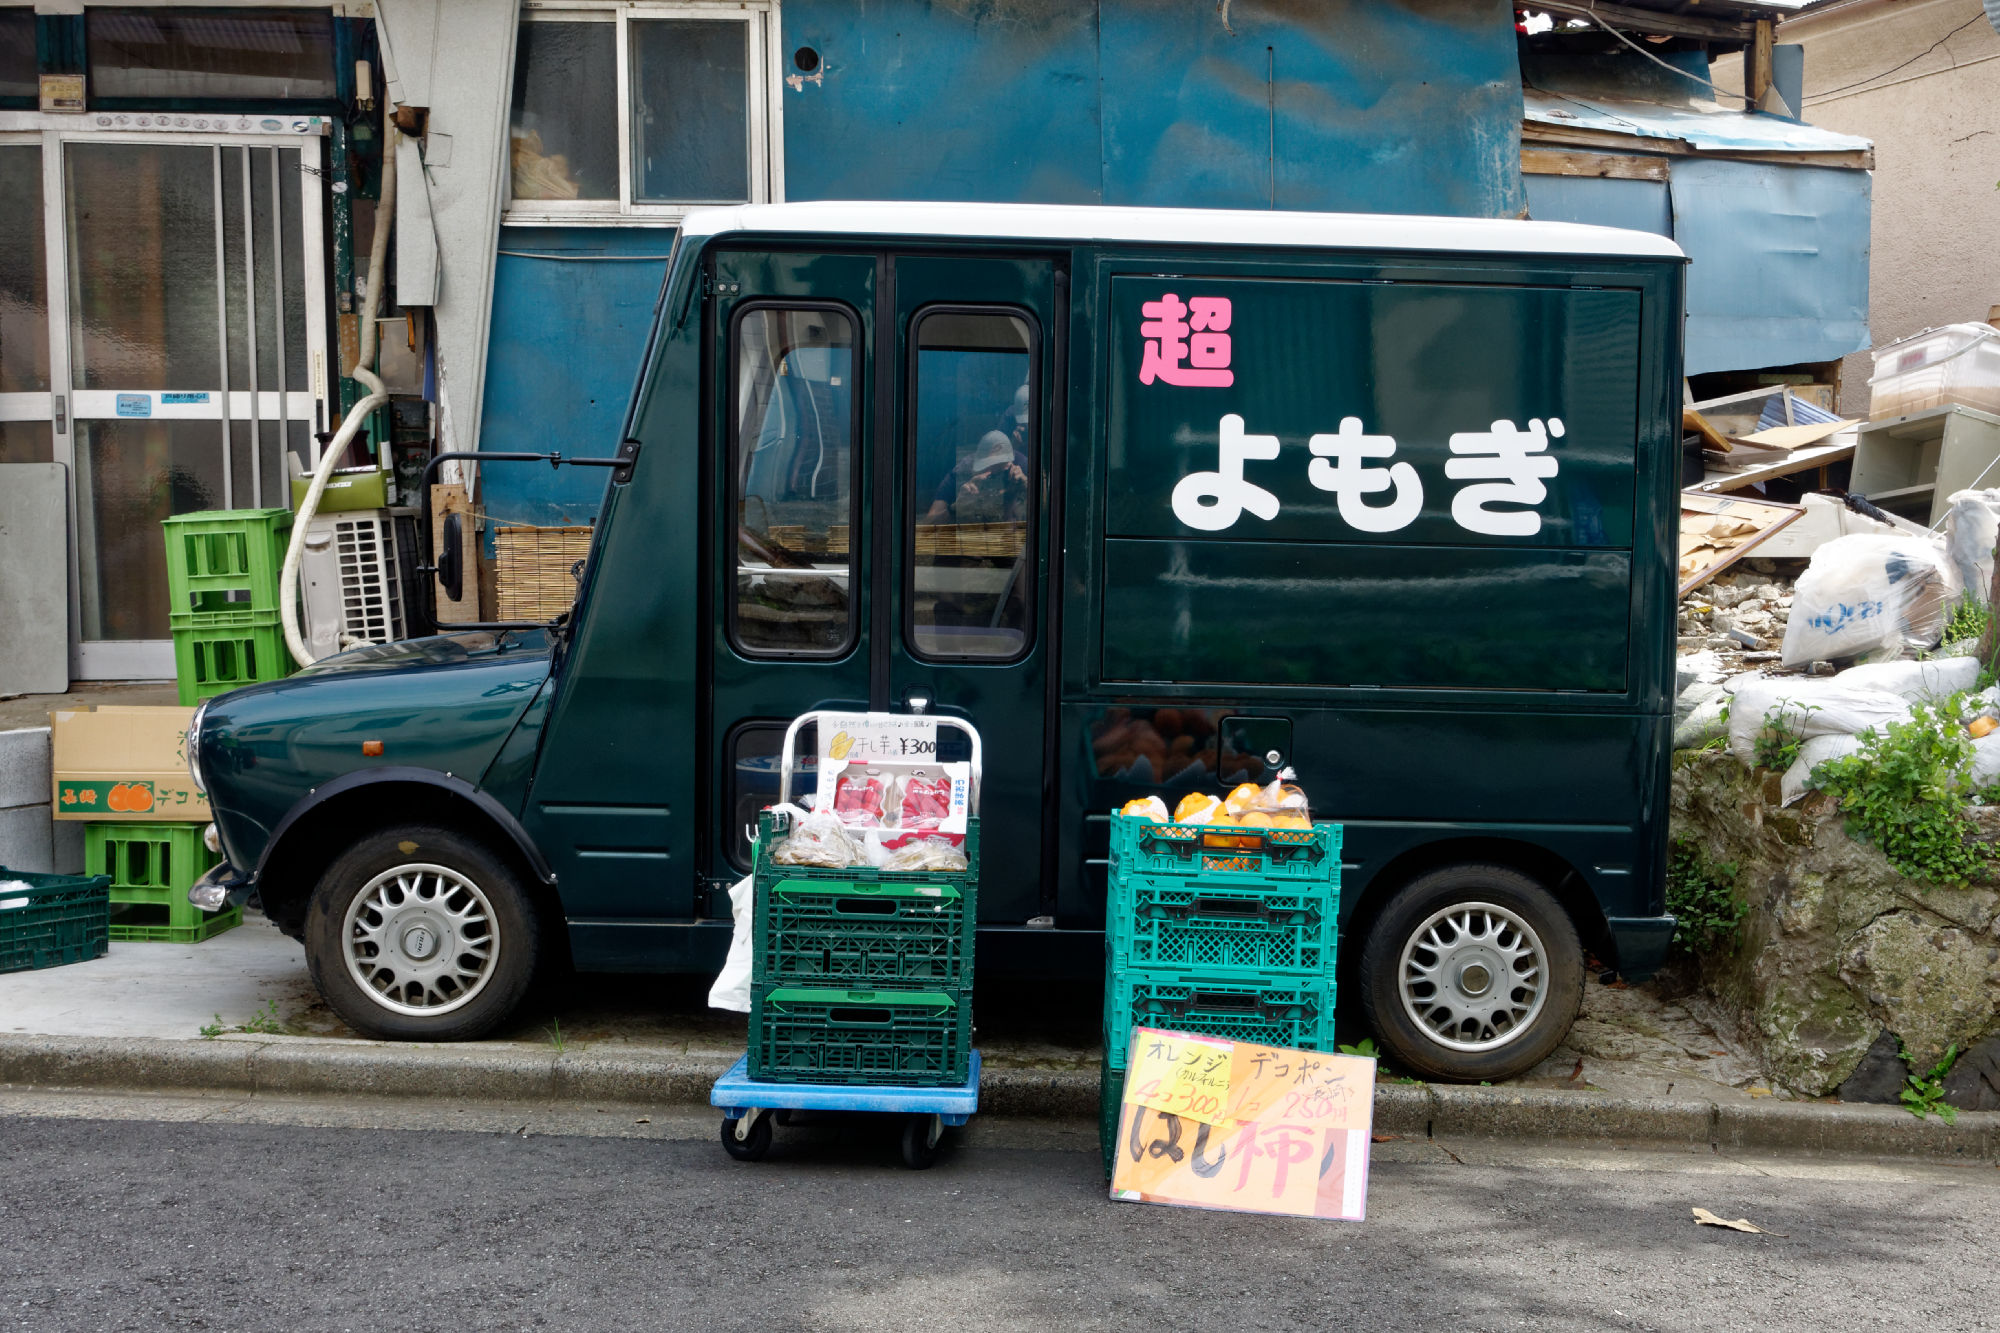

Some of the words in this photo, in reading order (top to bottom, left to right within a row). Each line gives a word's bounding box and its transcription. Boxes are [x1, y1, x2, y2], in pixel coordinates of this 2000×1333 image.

[1138, 293, 1234, 388] 超
[1171, 413, 1565, 536] よもぎ
[899, 737, 936, 755] ¥300
[1147, 1039, 1228, 1073] オレンジ
[1250, 1052, 1345, 1085] デコポン
